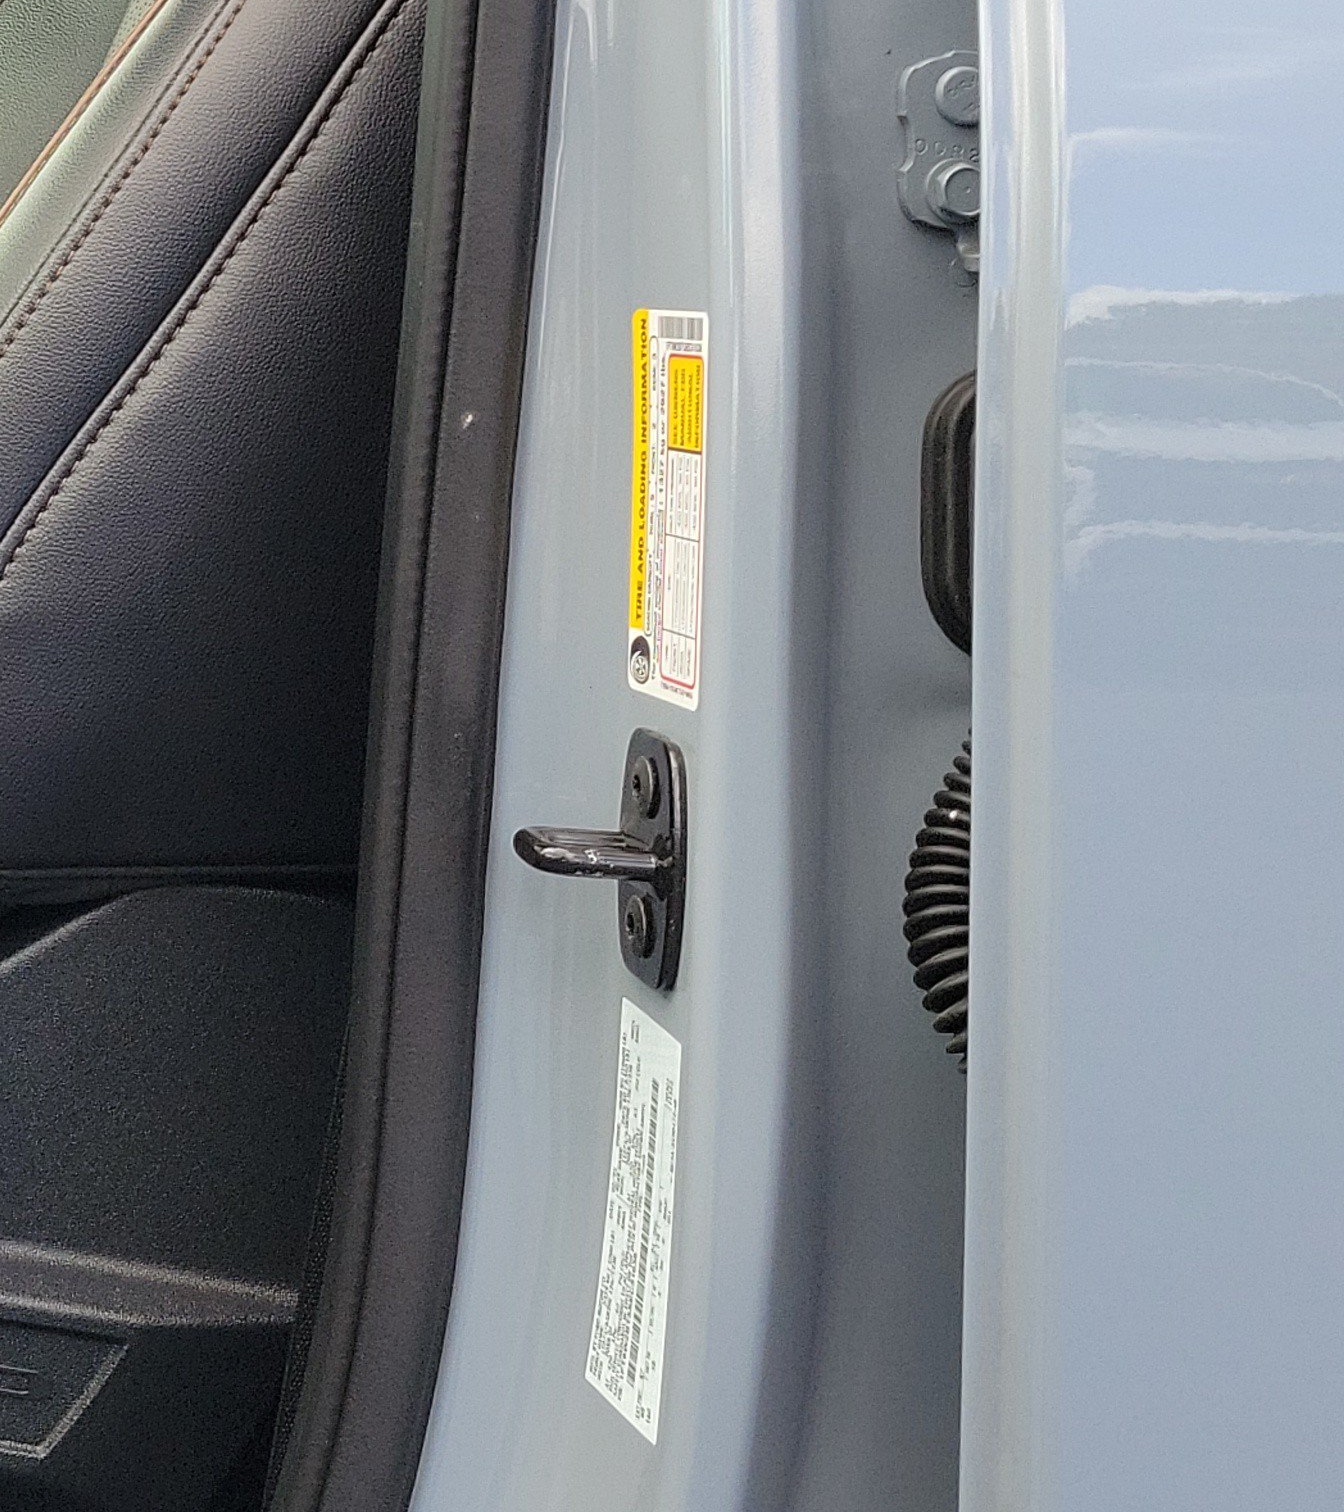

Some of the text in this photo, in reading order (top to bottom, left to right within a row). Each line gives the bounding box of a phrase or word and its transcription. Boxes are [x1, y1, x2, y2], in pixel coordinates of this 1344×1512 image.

[635, 318, 648, 620] TIRE AND LOADING INFORMATION
